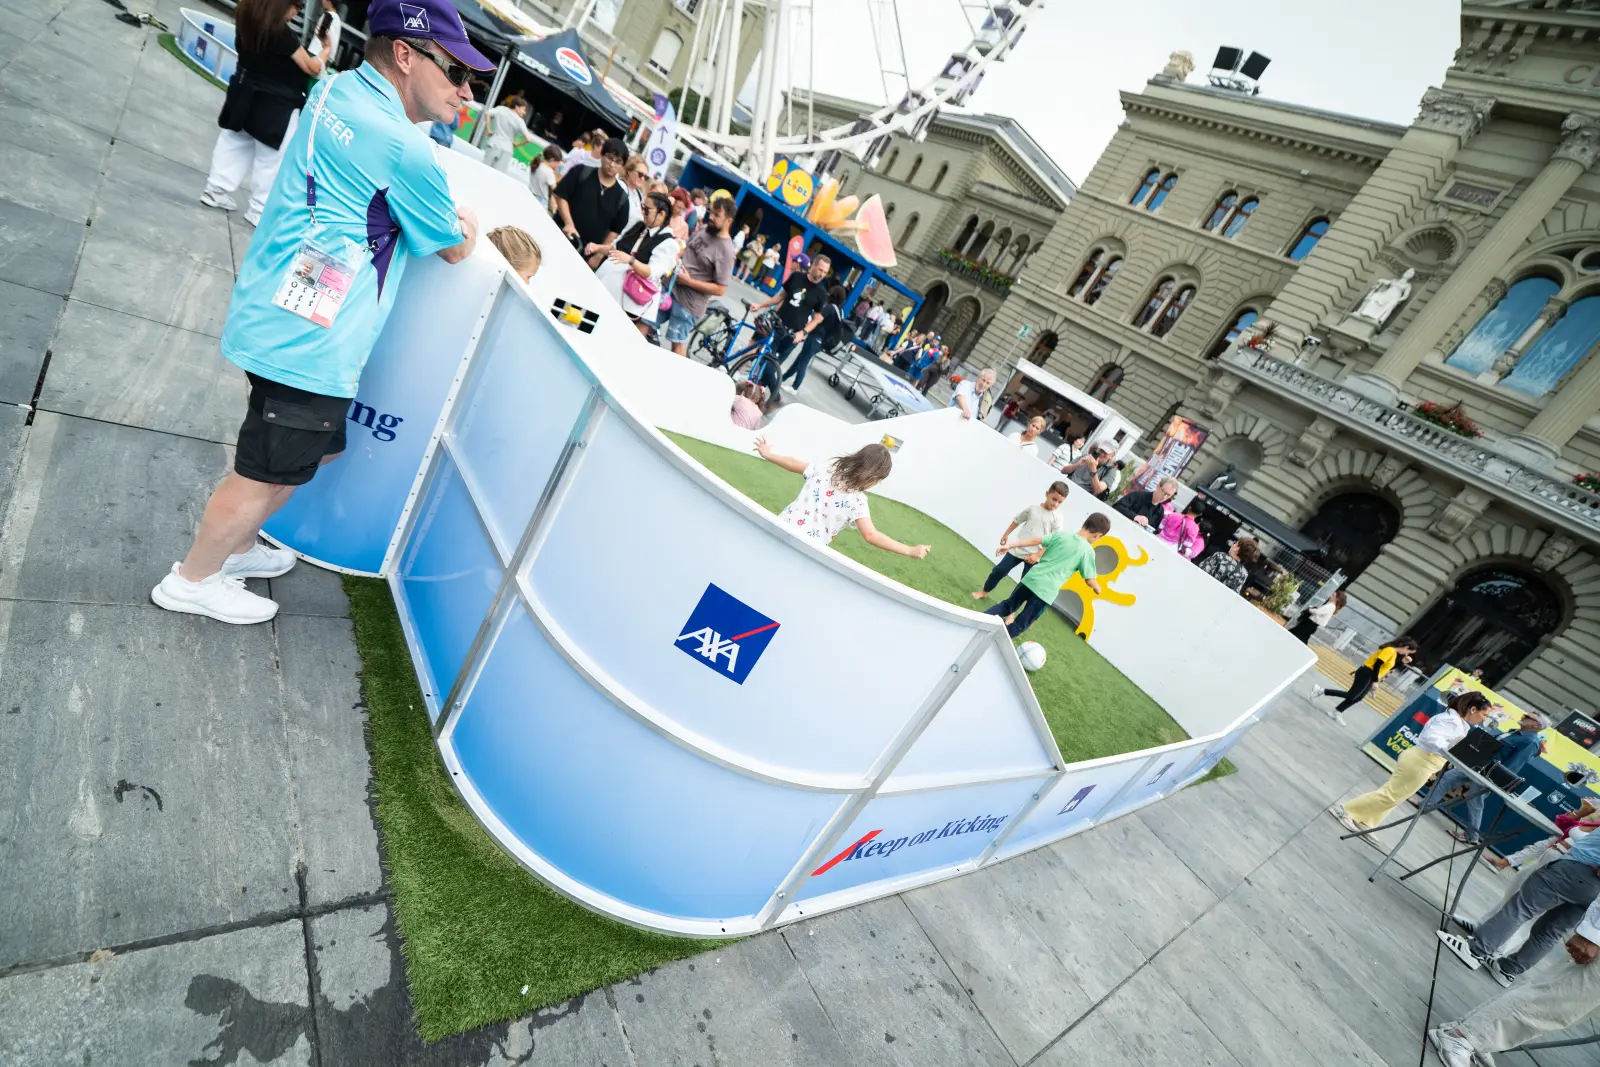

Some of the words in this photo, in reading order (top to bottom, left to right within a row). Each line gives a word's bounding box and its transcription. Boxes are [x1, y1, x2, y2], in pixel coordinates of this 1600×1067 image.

[404, 16, 425, 29] AXA
[677, 626, 740, 674] AXA
[1385, 737, 1403, 754] Ver
[843, 836, 909, 862] Keep
[908, 828, 938, 848] on
[935, 814, 1009, 839] Kicking
